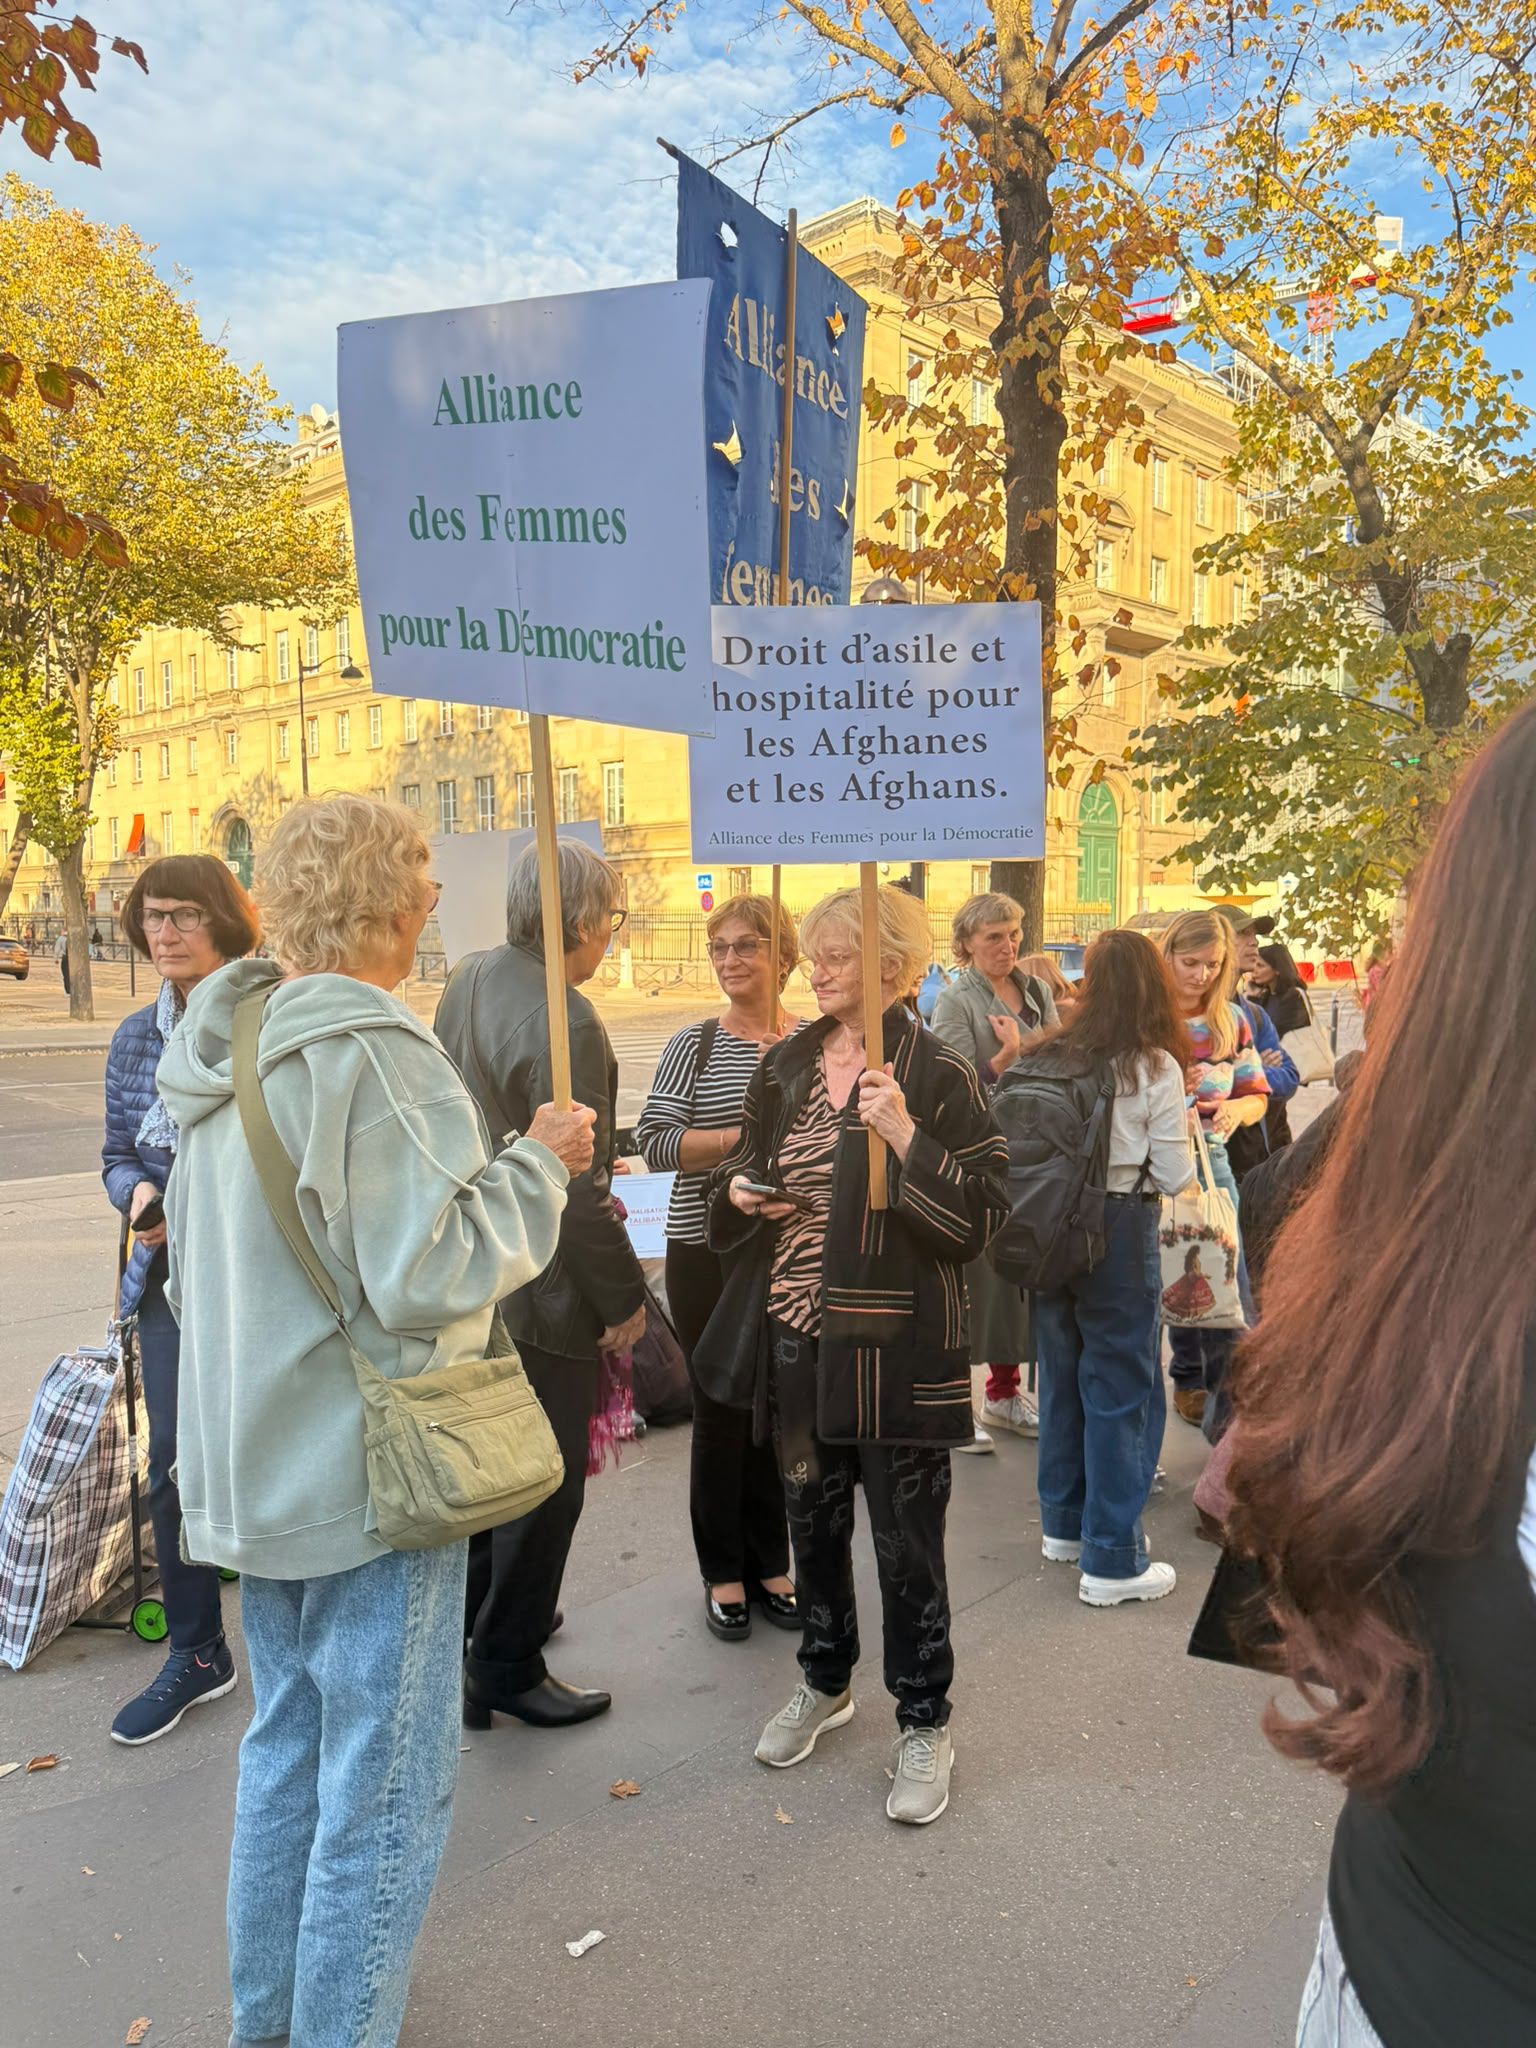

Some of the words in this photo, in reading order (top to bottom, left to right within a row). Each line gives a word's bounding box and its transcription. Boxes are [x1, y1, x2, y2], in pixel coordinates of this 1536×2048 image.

[432, 372, 584, 427] Alliance
[408, 495, 467, 542] des
[476, 494, 628, 546] Femmes
[378, 612, 451, 656] pour
[455, 606, 490, 652] la
[495, 608, 687, 673] Démocratie
[722, 636, 828, 666] Droit
[971, 636, 1006, 663] et
[713, 679, 915, 721] hospitalité
[927, 685, 1020, 719] pour
[743, 727, 795, 758] les
[809, 725, 988, 766] Afghanes
[726, 777, 761, 804] et
[773, 773, 825, 803] les
[838, 770, 1009, 811] Afghans.
[709, 830, 773, 845] Alliance
[777, 830, 805, 845] des
[811, 830, 875, 844] Femmes
[880, 830, 918, 847] pour
[923, 827, 937, 842] la
[943, 825, 1034, 841] Démocratie
